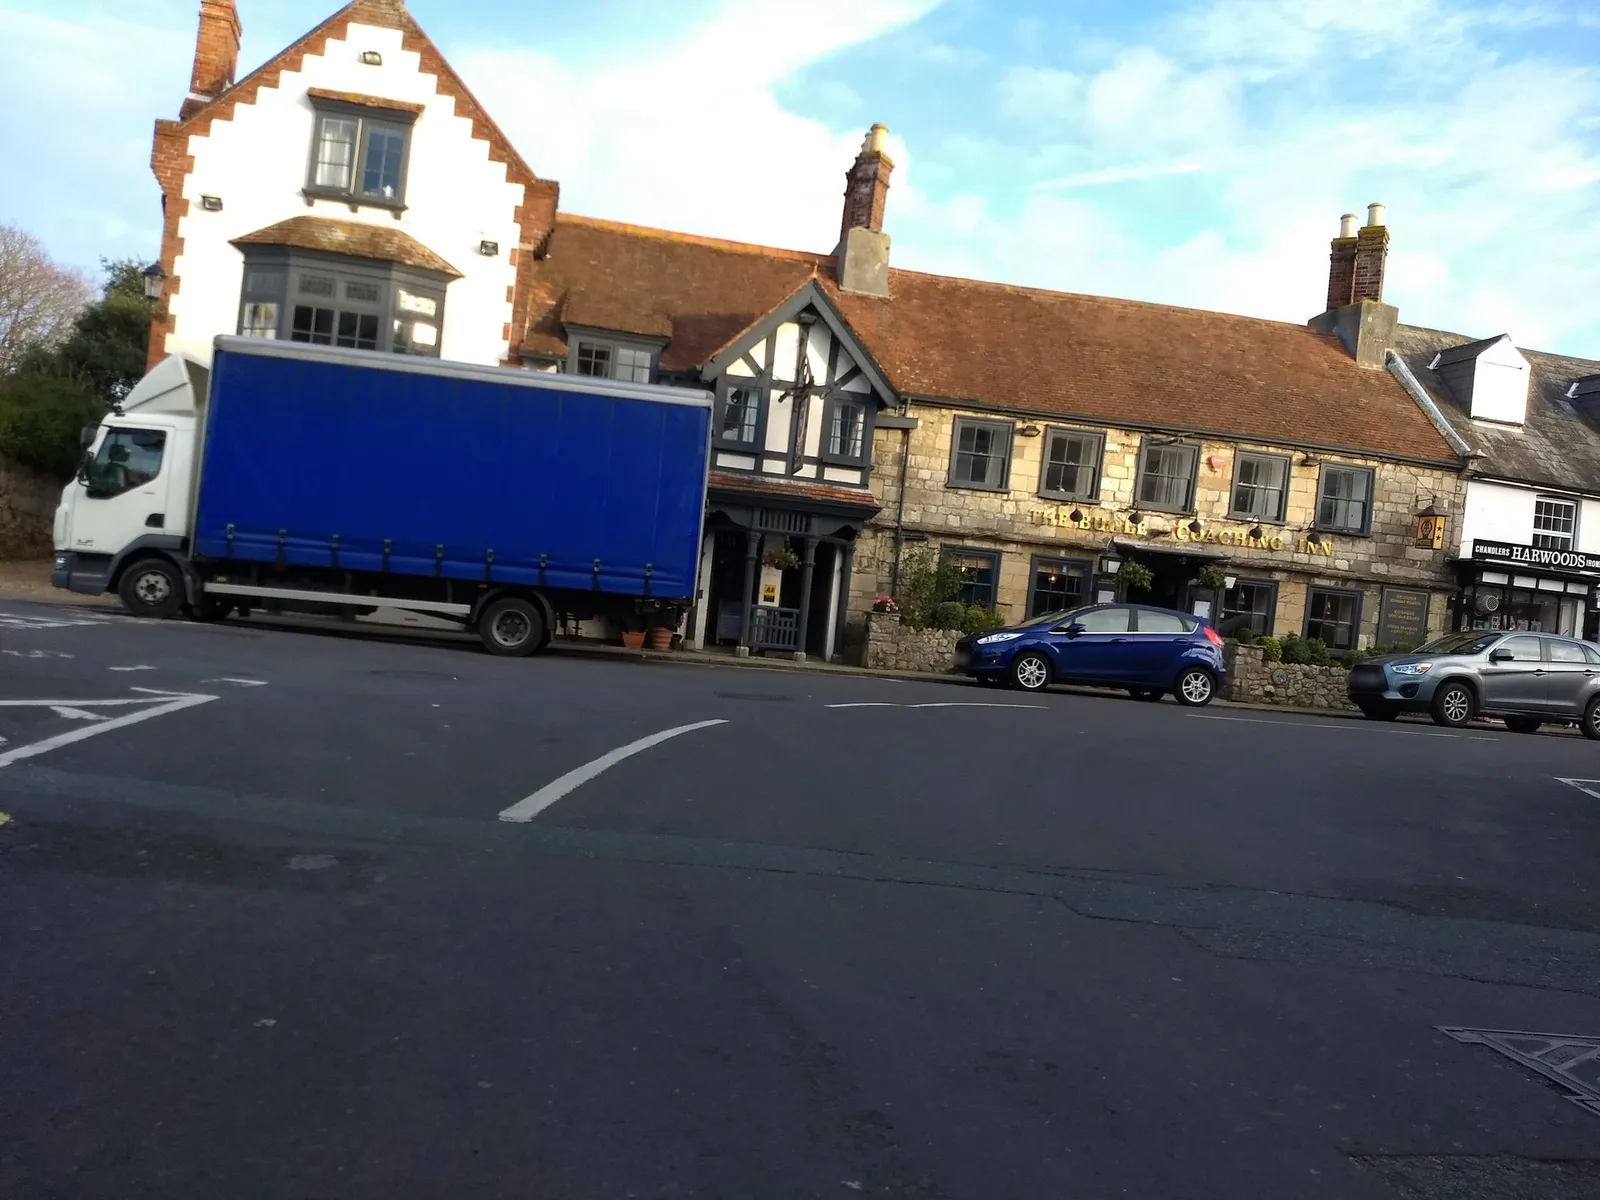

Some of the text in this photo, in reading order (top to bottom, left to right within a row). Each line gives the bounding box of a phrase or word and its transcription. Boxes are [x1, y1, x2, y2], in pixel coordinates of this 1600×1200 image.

[1030, 510, 1070, 528] THE
[1175, 525, 1284, 551] COACHING
[1297, 537, 1333, 556] INN
[1475, 545, 1510, 557] CHANDLERS
[1511, 546, 1586, 568] HARWOODS
